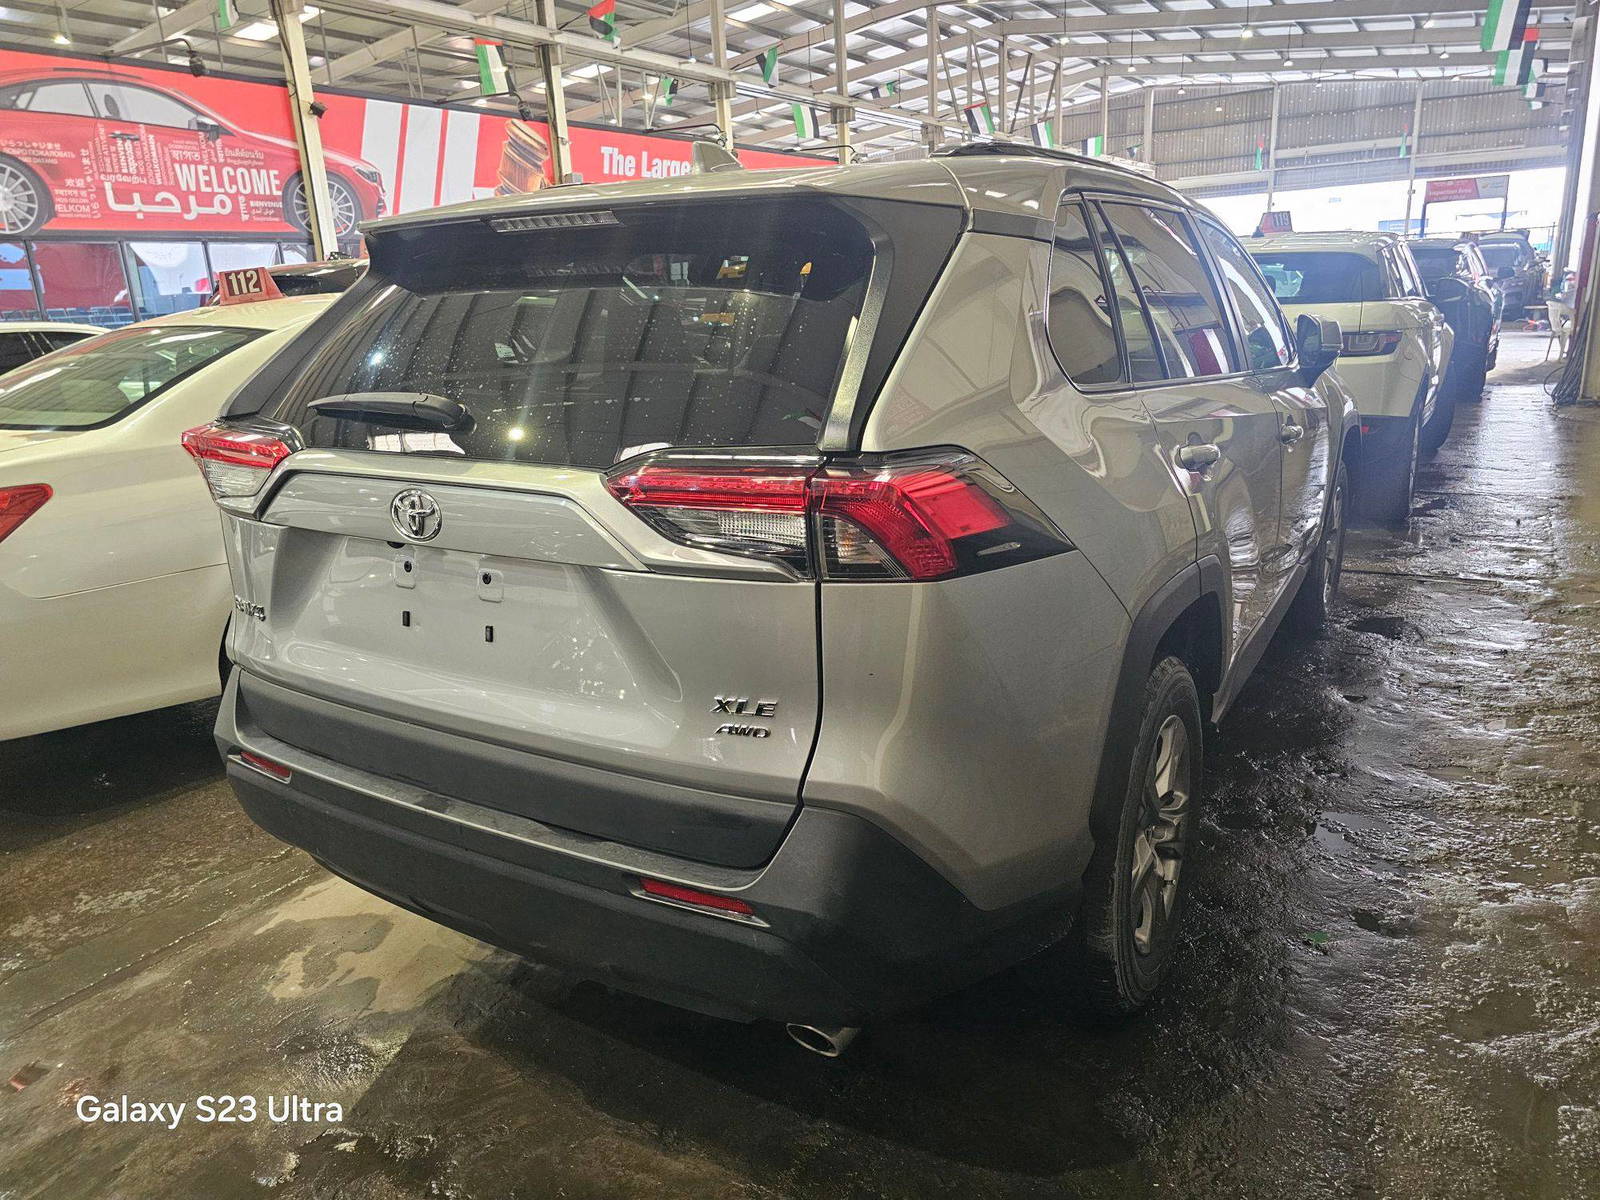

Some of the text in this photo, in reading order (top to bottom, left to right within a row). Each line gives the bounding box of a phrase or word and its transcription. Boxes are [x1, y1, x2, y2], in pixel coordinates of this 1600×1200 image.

[601, 146, 635, 176] The
[174, 163, 282, 196] WELCOME
[104, 181, 233, 220] مرحبا
[228, 271, 260, 295] 112
[709, 696, 778, 717] XLE
[712, 723, 772, 739] AWD
